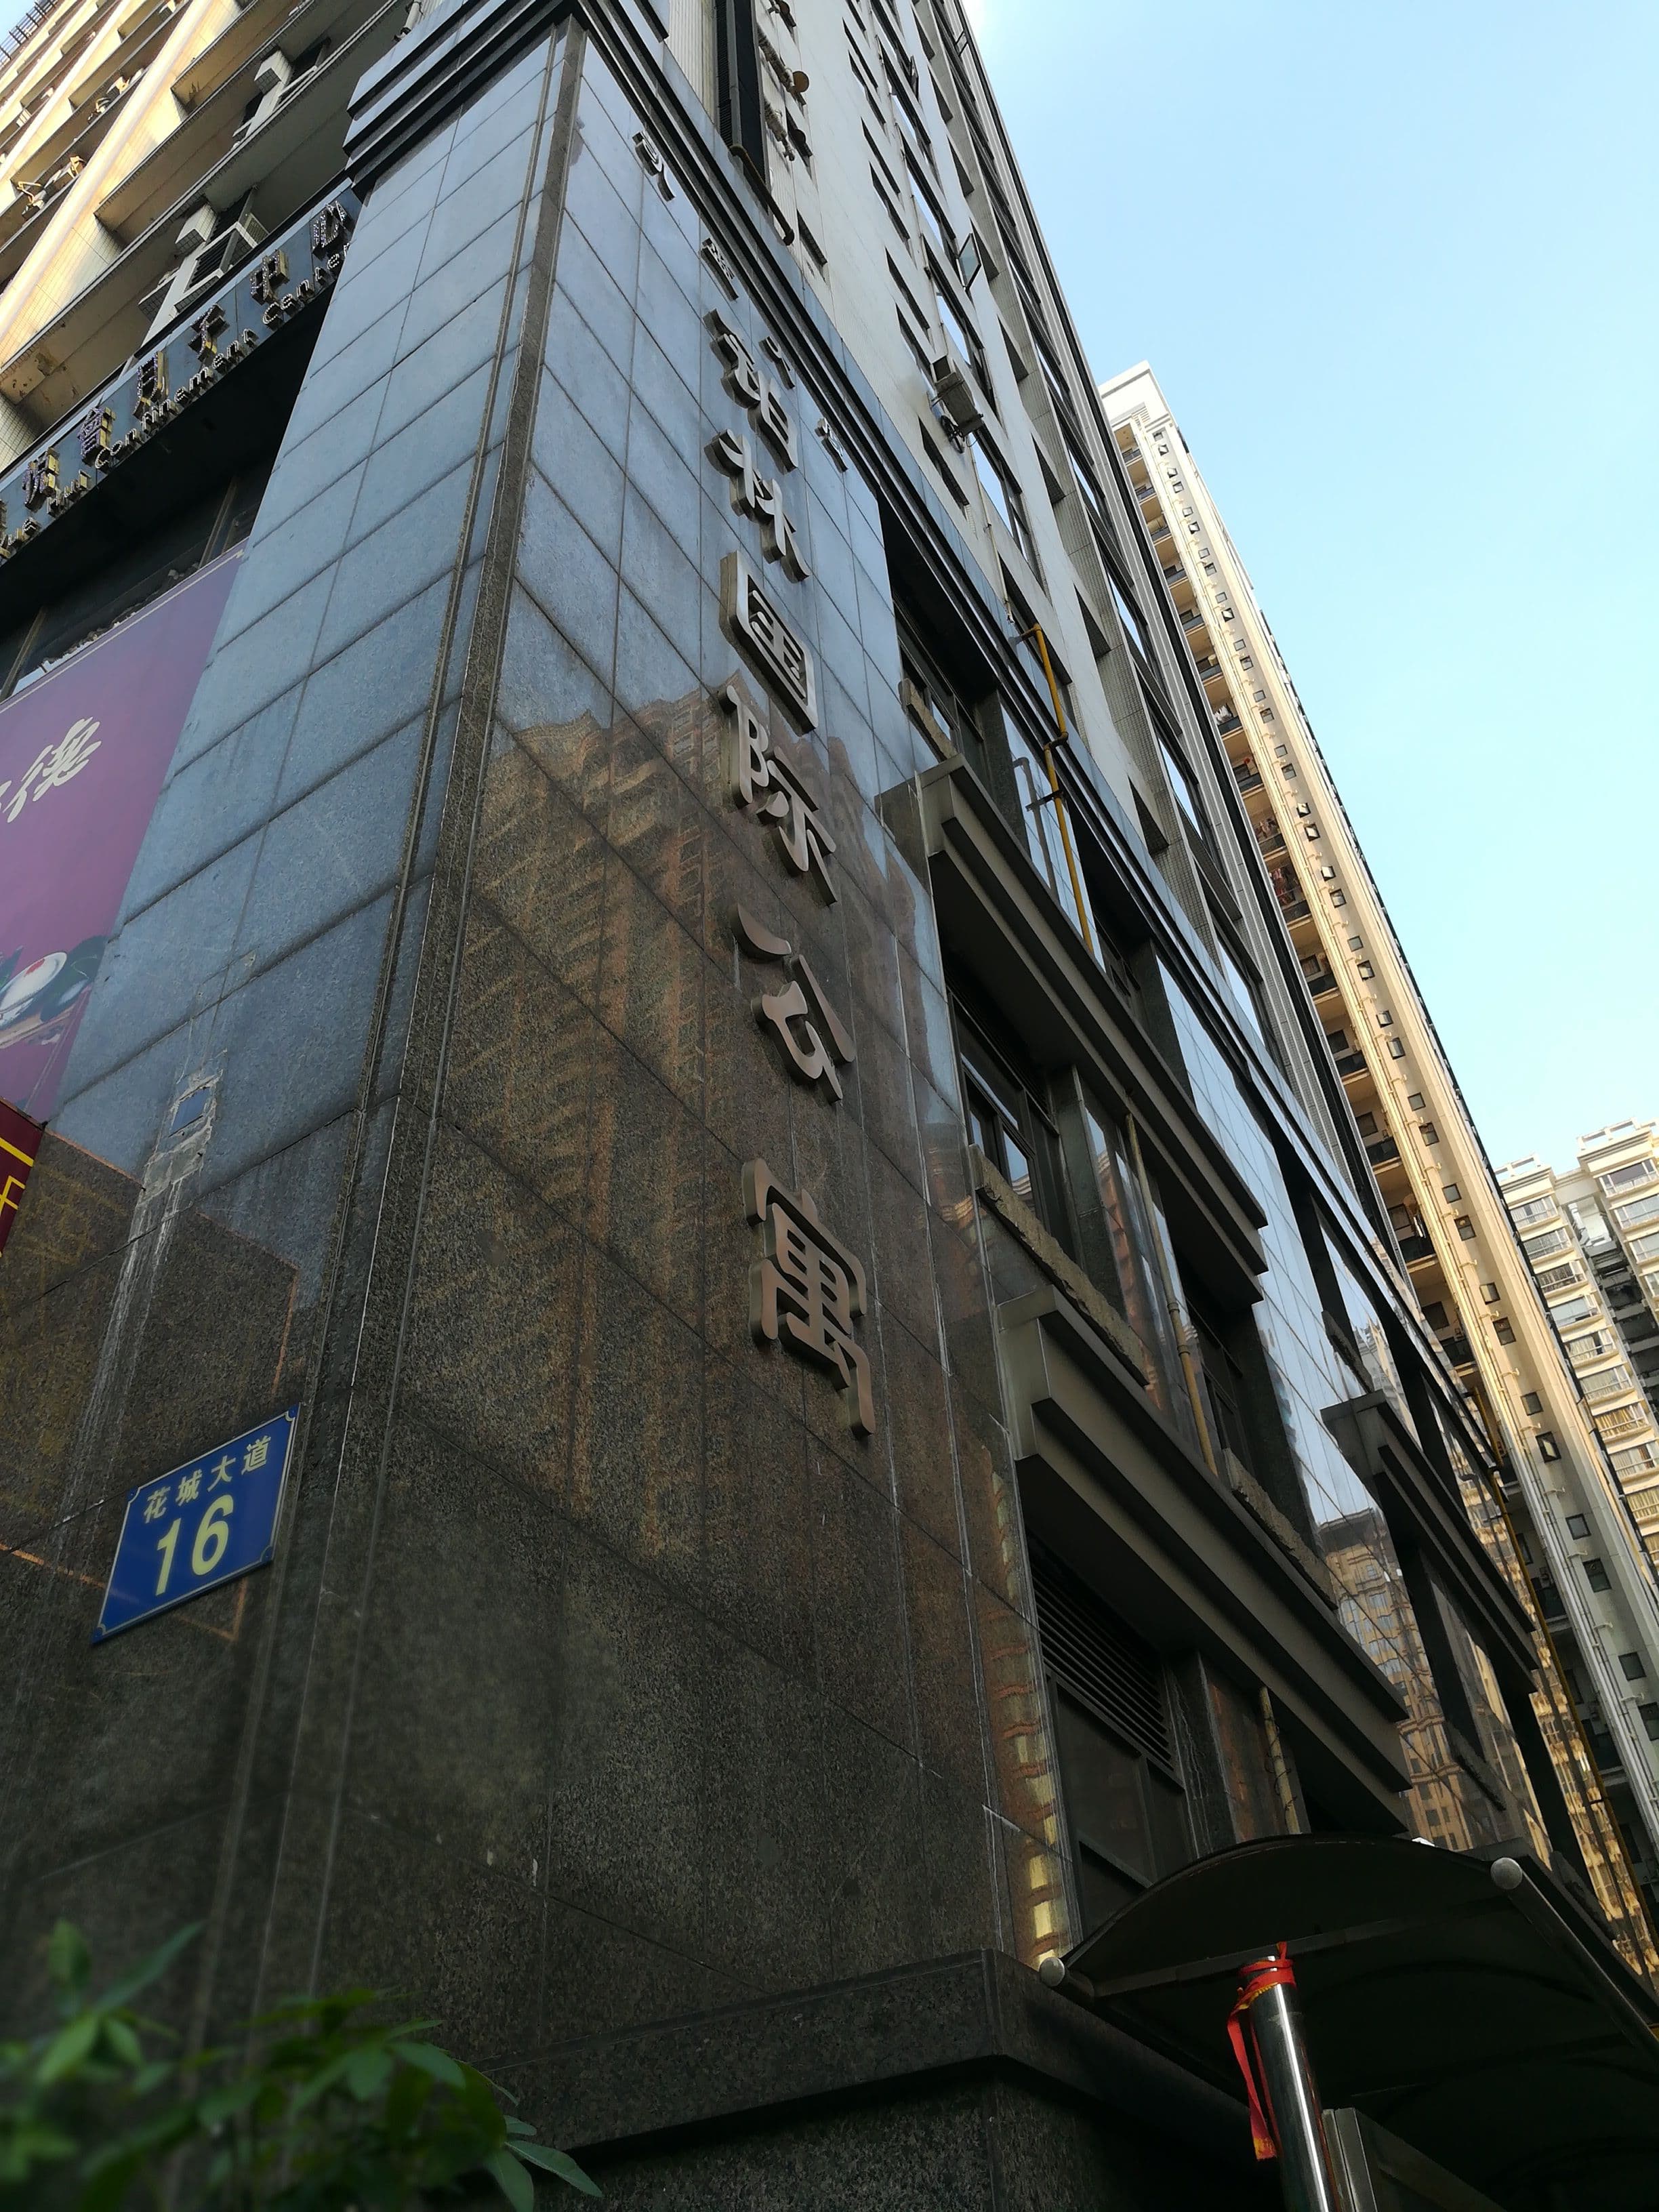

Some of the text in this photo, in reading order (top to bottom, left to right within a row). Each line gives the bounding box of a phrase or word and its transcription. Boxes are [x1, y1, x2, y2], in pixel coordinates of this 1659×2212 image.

[95, 328, 260, 474] Confinement
[704, 308, 876, 1437] 铂林国际公寓
[143, 1435, 271, 1523] 花城大道
[156, 1494, 234, 1597] 16
